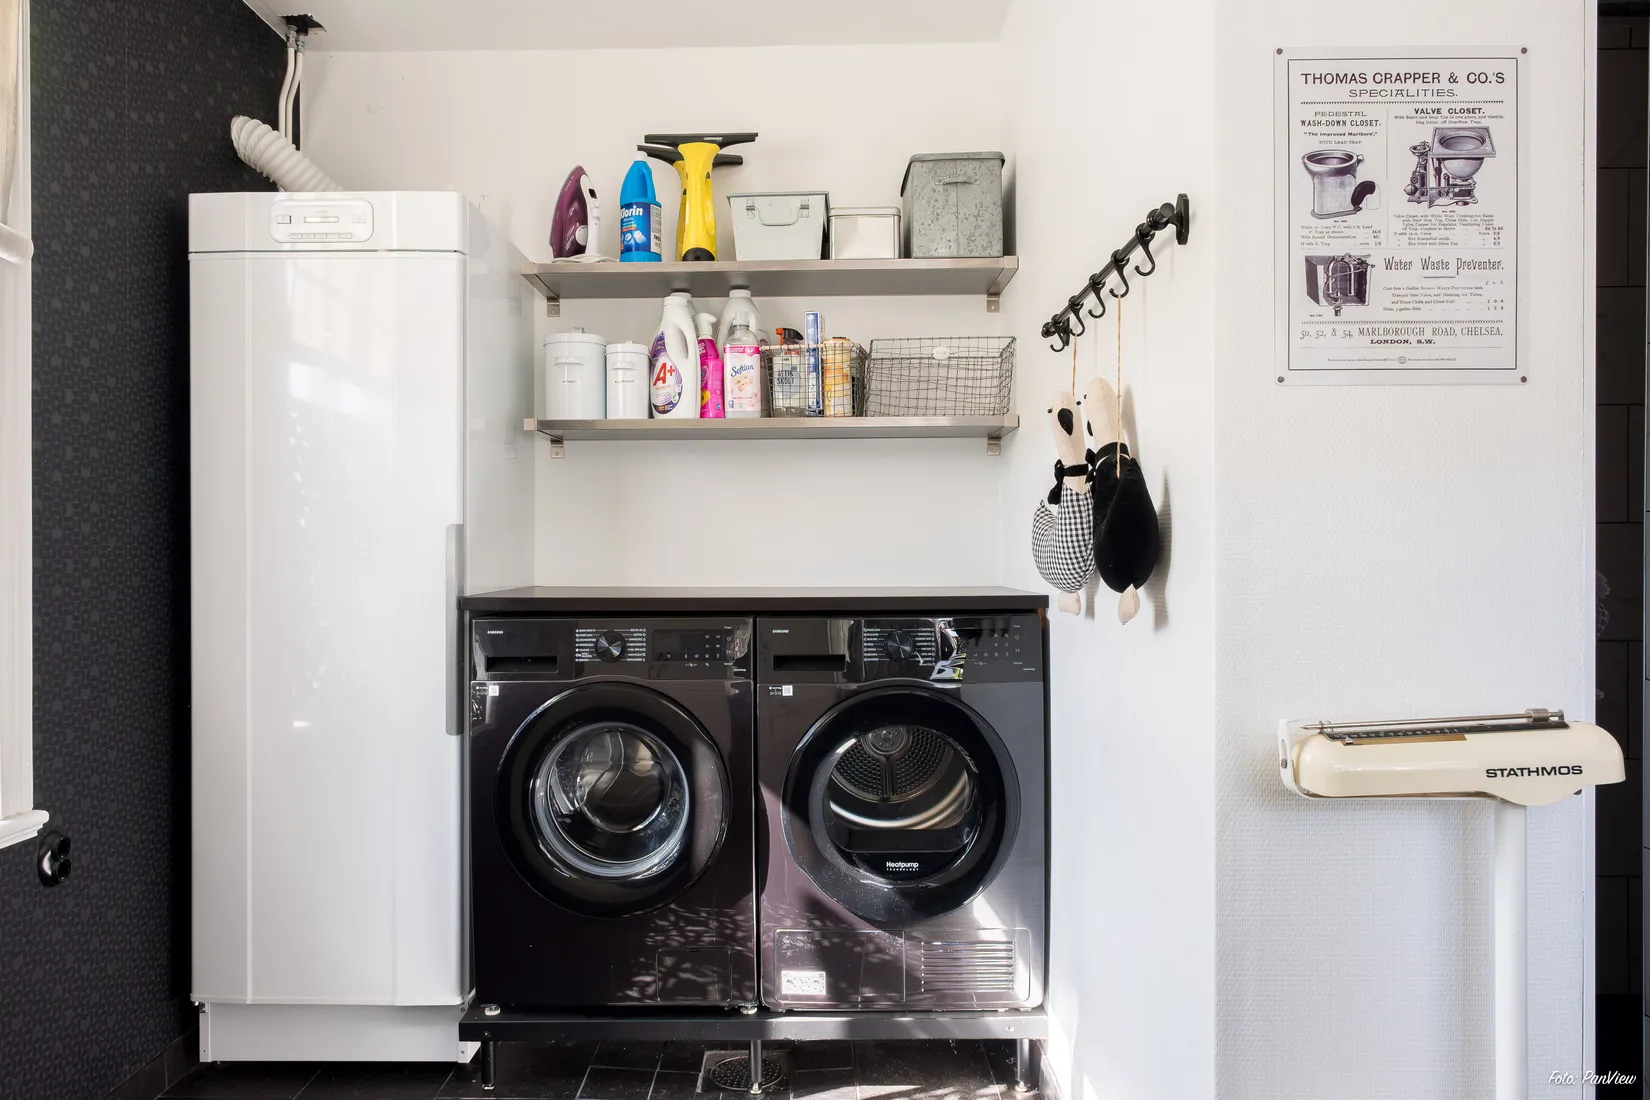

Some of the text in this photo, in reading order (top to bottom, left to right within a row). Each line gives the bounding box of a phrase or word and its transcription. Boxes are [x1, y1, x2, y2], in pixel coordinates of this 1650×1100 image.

[1300, 72, 1505, 84] THOMAS CRAPPER & CO.'S
[1348, 89, 1458, 97] SPECIALITIES.
[1384, 256, 1504, 275] Water Waste Preventer.
[1300, 330, 1312, 339] 50,
[1315, 330, 1326, 339] 52,
[1331, 328, 1337, 336] &
[1358, 327, 1425, 336] MARLBOROUGH
[1432, 327, 1457, 337] ROAD,
[1461, 327, 1503, 336] CHELSEA.
[653, 362, 675, 386] A+
[1486, 765, 1583, 778] STATHMOS
